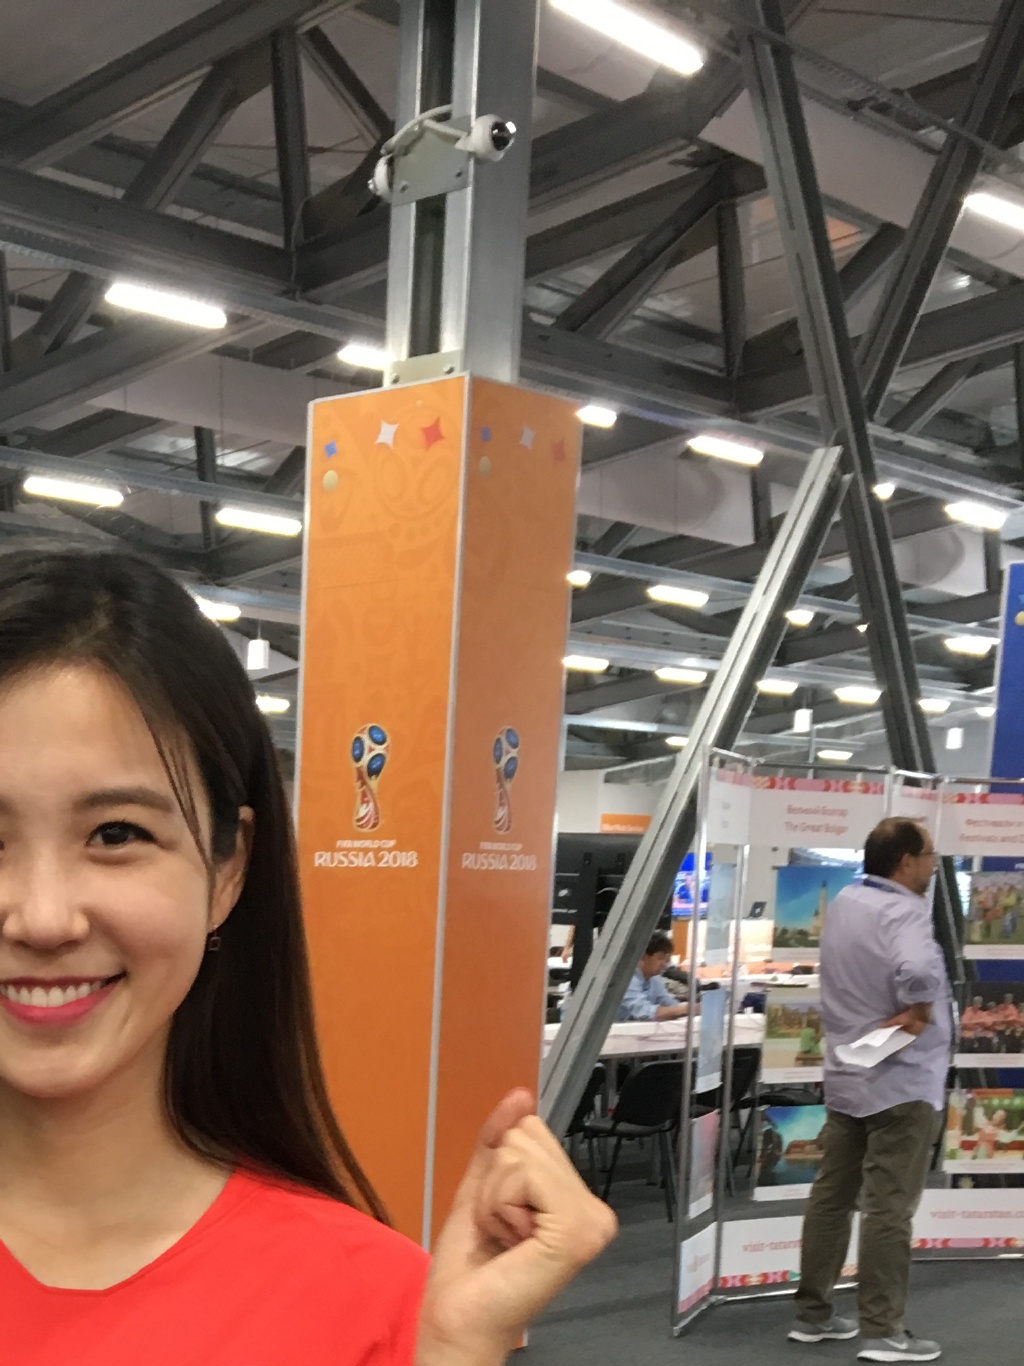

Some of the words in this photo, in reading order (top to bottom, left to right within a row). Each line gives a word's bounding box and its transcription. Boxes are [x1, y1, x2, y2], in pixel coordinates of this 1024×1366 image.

[314, 851, 376, 867] RUSSIA
[377, 850, 418, 867] 2018
[461, 852, 509, 870] RUSSIA
[510, 854, 537, 871] 2018
